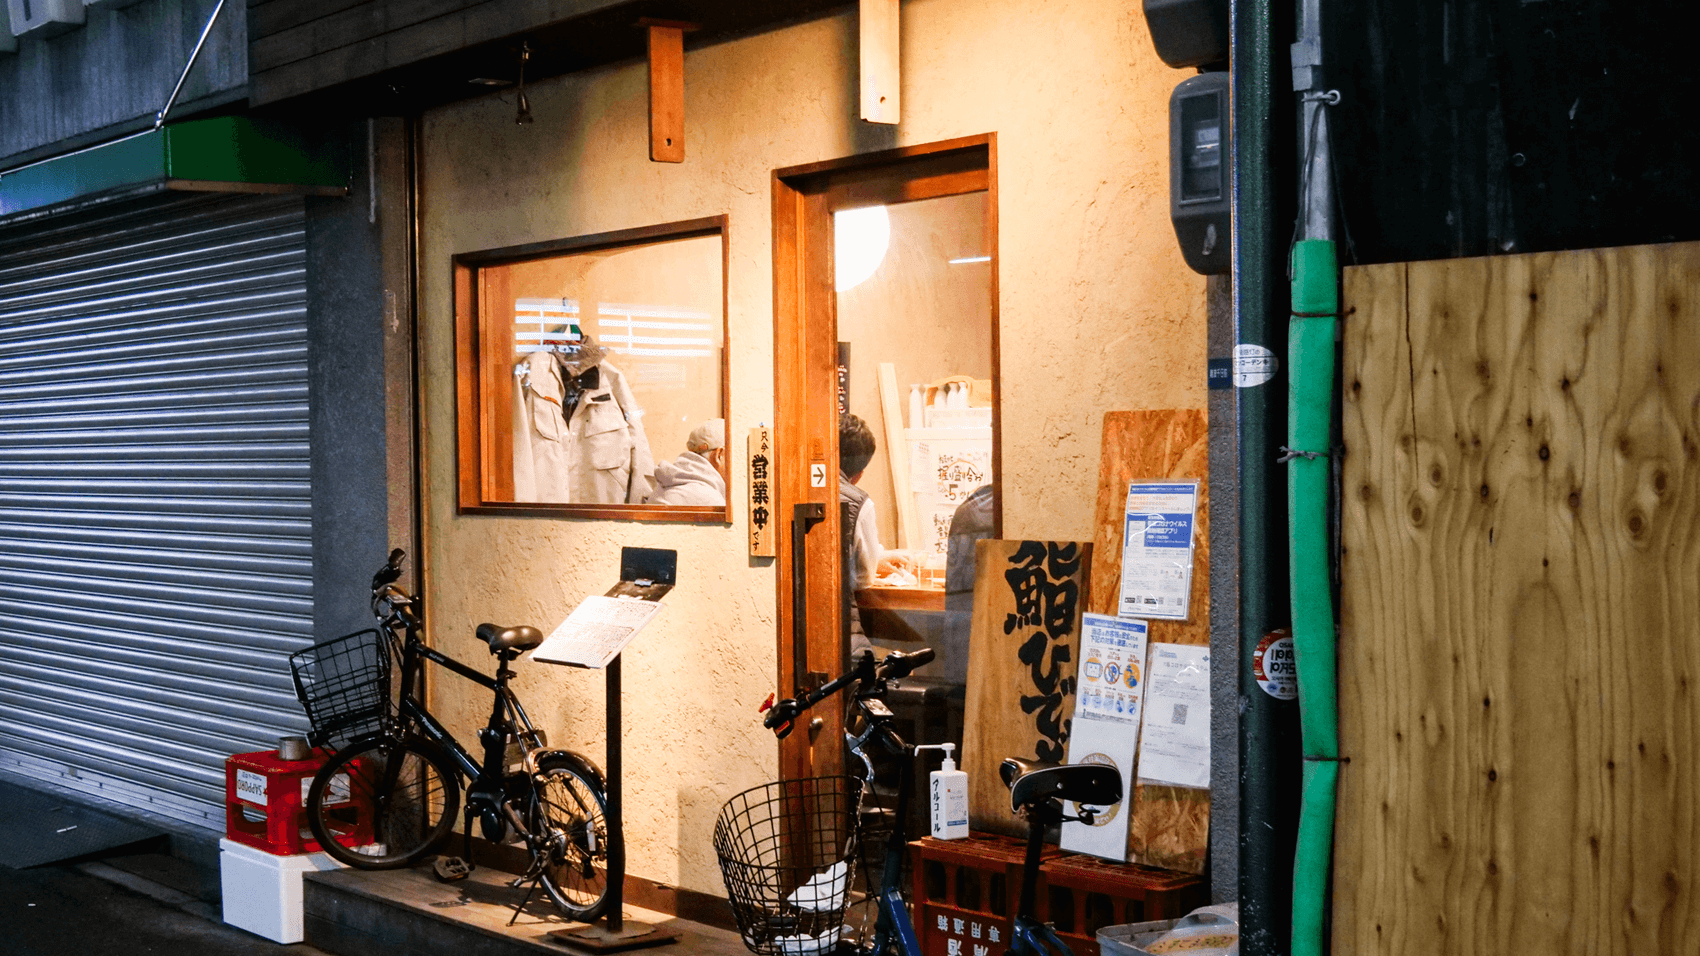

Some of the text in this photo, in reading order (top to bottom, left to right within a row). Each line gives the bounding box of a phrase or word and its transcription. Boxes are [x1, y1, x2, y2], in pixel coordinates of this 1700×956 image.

[1242, 374, 1248, 382] 7
[237, 780, 262, 795] SAPPORO
[932, 778, 941, 833] アルコール
